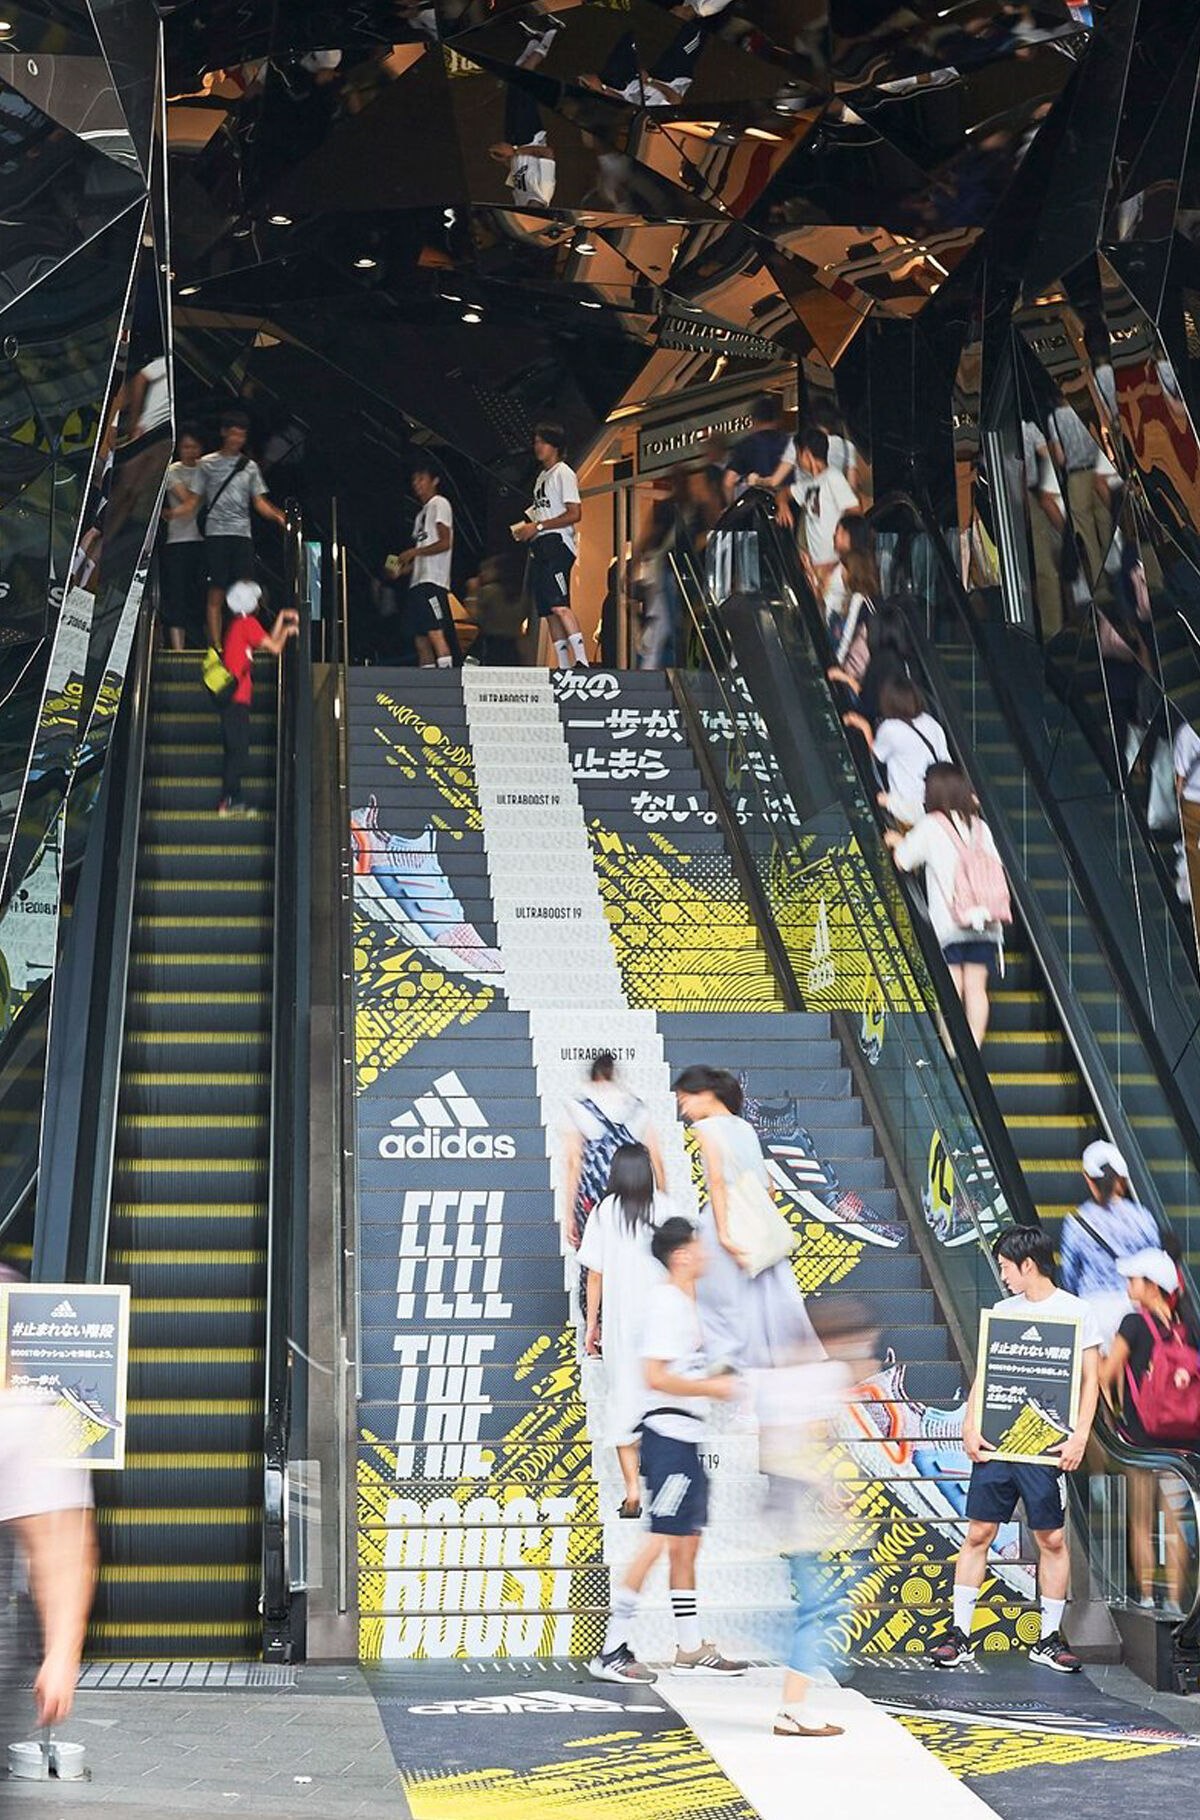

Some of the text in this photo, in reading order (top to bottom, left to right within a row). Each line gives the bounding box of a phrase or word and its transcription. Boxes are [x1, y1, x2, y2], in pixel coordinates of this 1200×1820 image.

[552, 671, 621, 701] 次の
[572, 748, 670, 780] 止まら
[496, 794, 561, 805] ULTRABOOST 19
[515, 907, 582, 919] ULTRABOOST 19
[625, 1047, 636, 1060] 19
[378, 1127, 517, 1159] adidas
[396, 1190, 513, 1319] FEEL
[393, 1334, 496, 1478] THE
[707, 1453, 720, 1469] 19
[379, 1496, 579, 1659] BOOST
[407, 1702, 667, 1715] adidas
